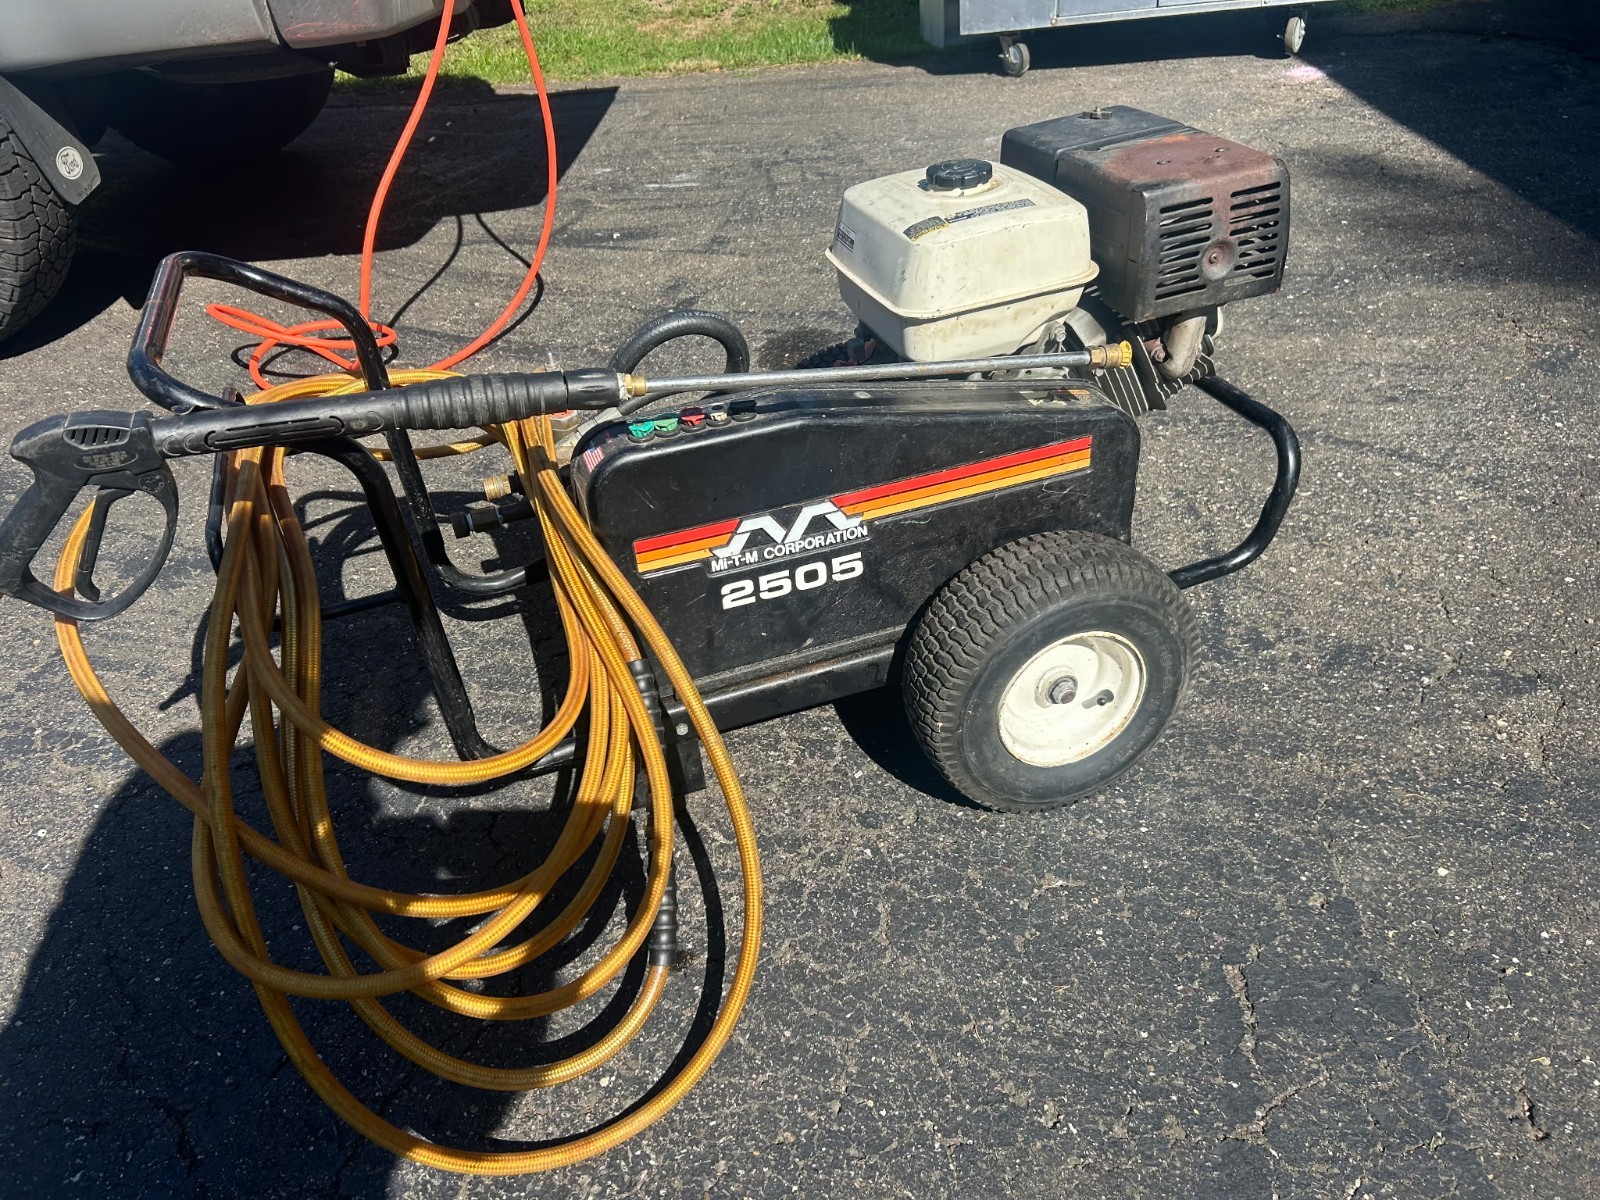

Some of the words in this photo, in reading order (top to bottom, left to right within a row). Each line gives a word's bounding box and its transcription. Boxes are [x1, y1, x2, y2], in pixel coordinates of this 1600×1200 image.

[711, 551, 759, 573] Mi-T-M
[763, 525, 868, 560] CORPORATION
[720, 551, 864, 610] 2505
